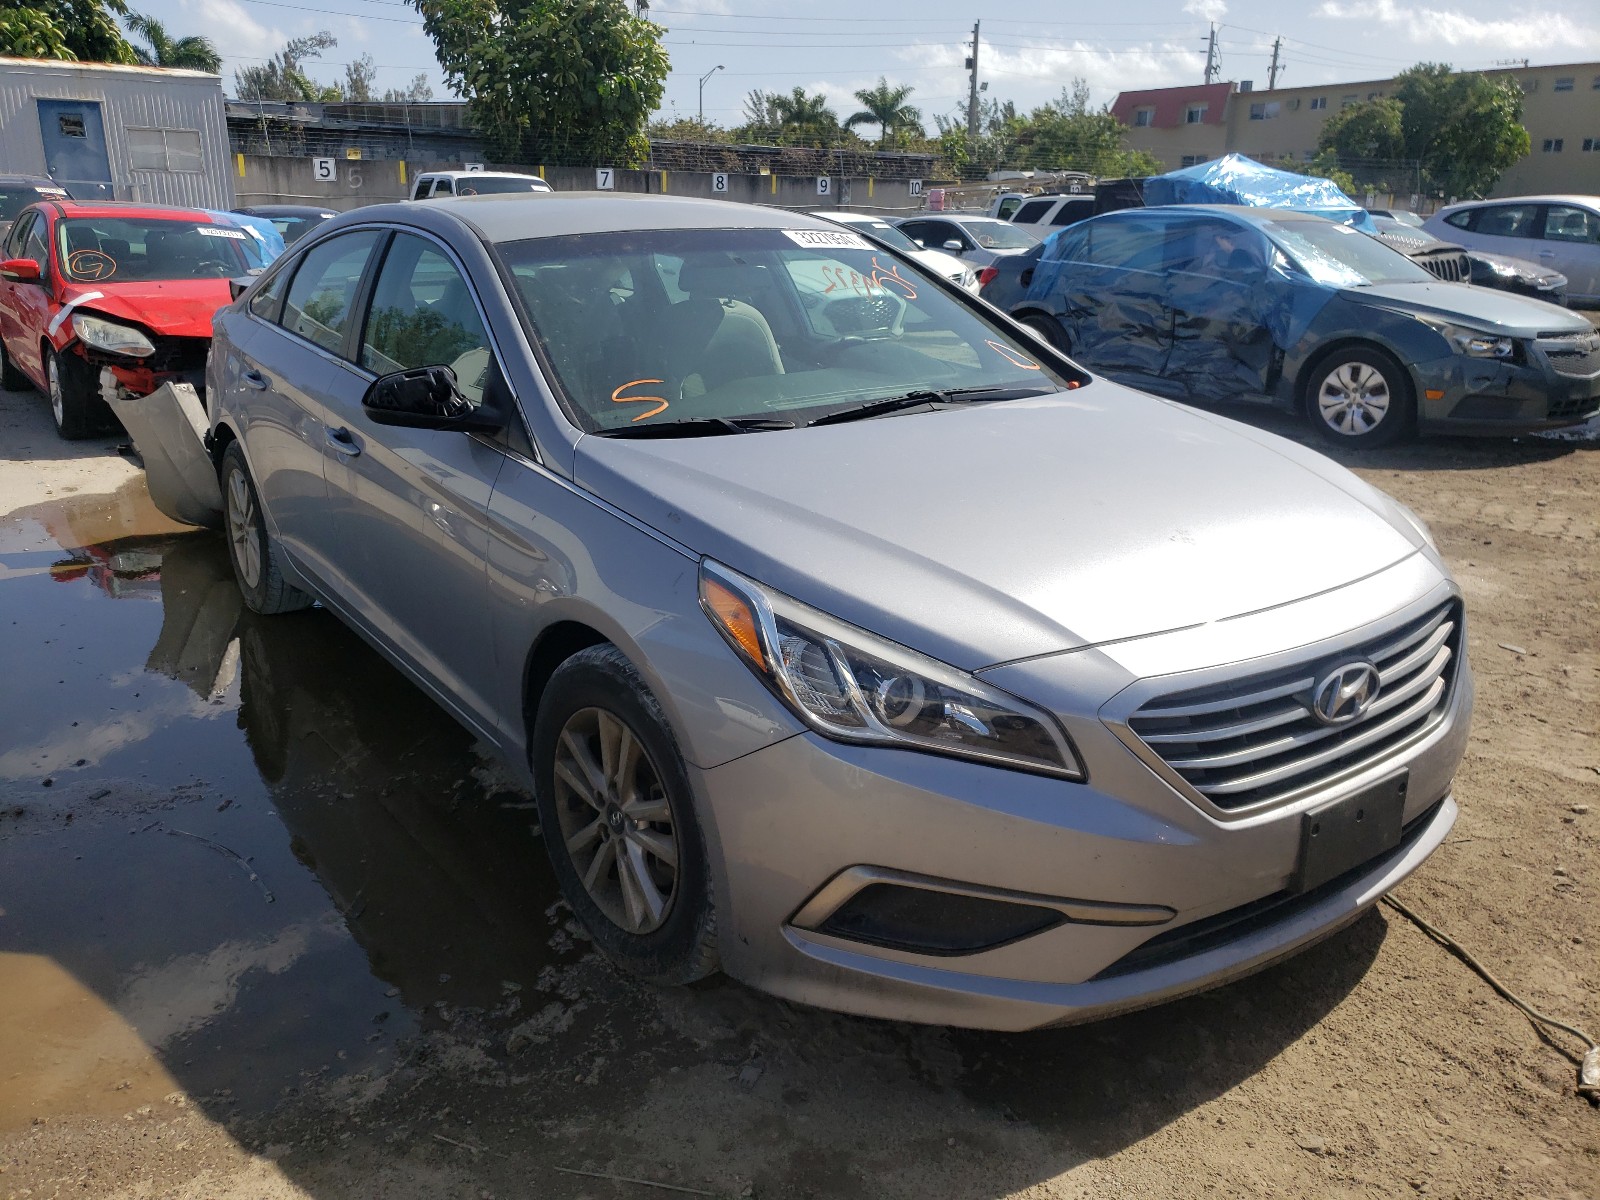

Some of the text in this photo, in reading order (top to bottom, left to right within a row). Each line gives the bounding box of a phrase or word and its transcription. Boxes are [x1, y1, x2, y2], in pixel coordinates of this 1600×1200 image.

[319, 160, 331, 178] 5
[349, 167, 363, 189] 5
[600, 171, 610, 187] 7
[716, 175, 725, 190] 8
[820, 179, 828, 193] 9
[910, 182, 920, 195] 10
[611, 378, 670, 423] S
